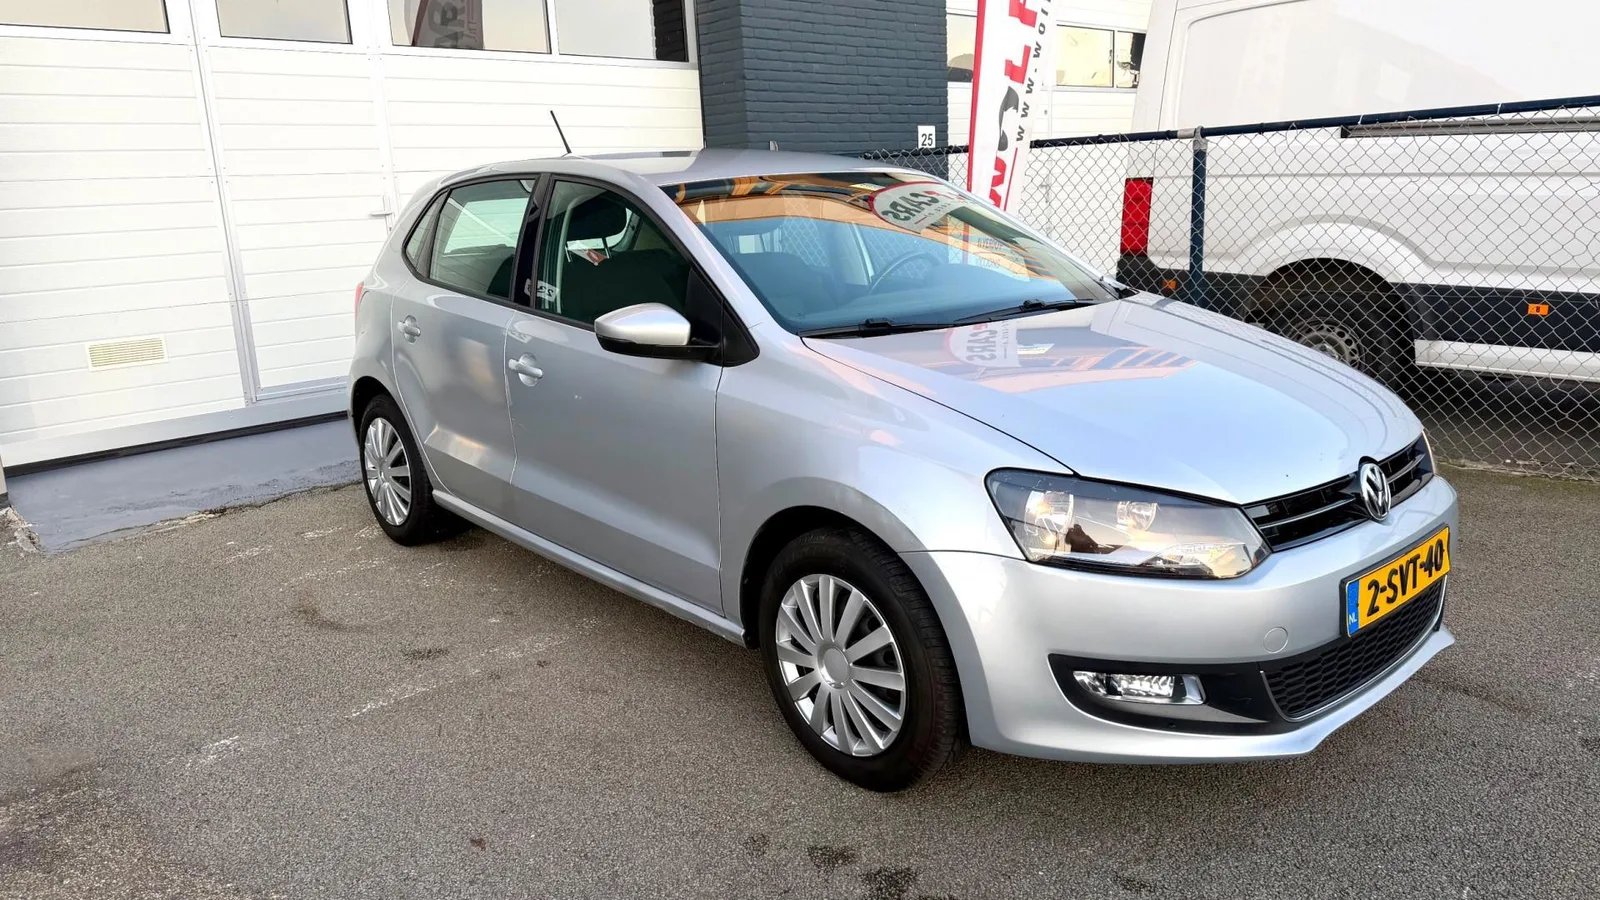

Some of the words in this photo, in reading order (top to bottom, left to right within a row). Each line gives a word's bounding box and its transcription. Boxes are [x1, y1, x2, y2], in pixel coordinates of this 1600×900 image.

[1016, 0, 1052, 142] www.wol
[921, 133, 934, 147] 25
[1366, 538, 1445, 617] 2-SVT-40
[1348, 612, 1357, 625] NL
